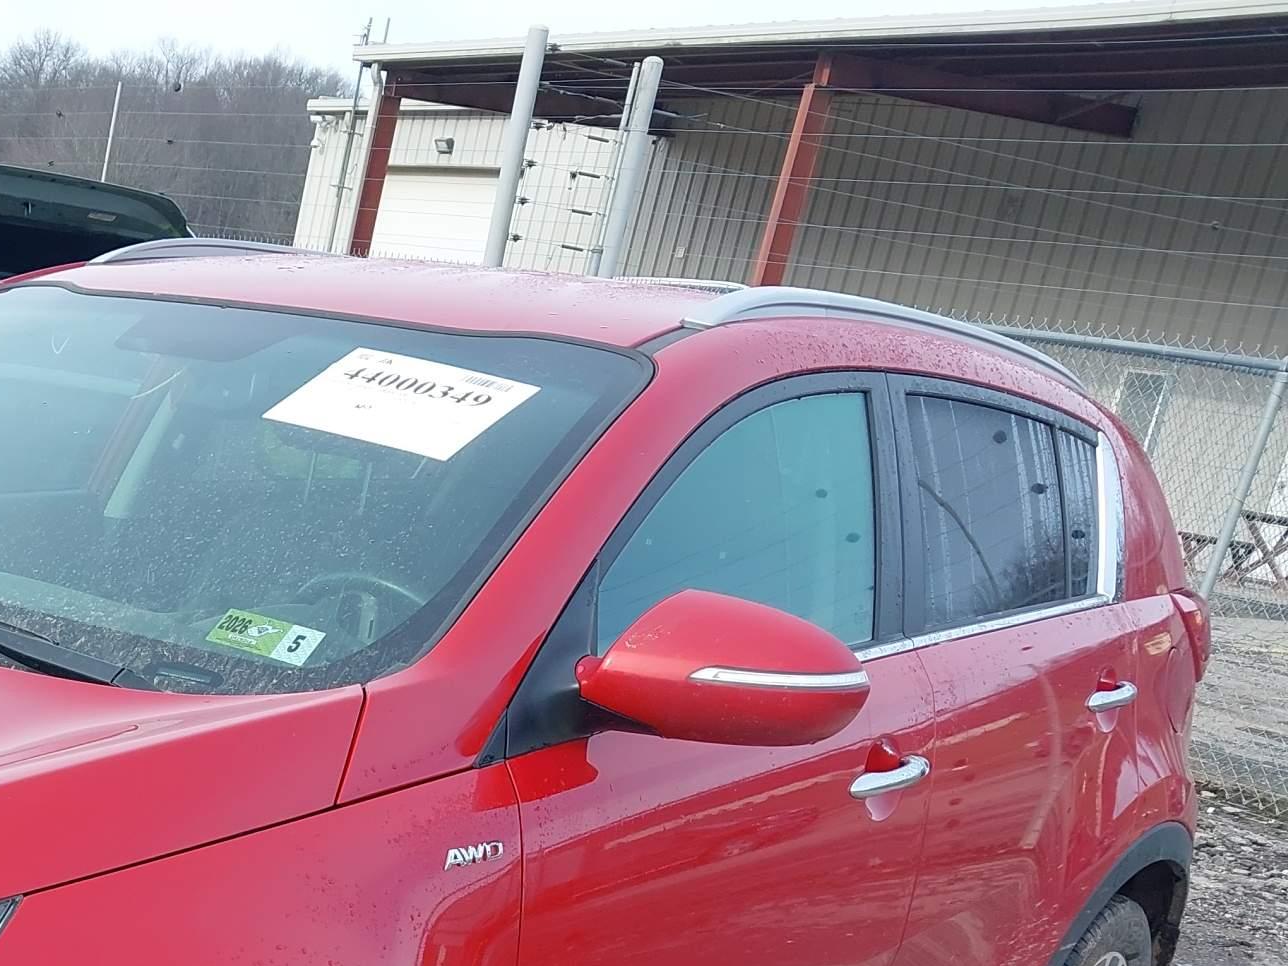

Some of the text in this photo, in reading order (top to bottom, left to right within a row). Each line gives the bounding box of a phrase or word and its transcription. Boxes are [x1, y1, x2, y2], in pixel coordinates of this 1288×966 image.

[343, 367, 493, 407] 44000349
[217, 614, 253, 635] 2026
[286, 634, 307, 653] 5
[443, 841, 504, 871] AWD
